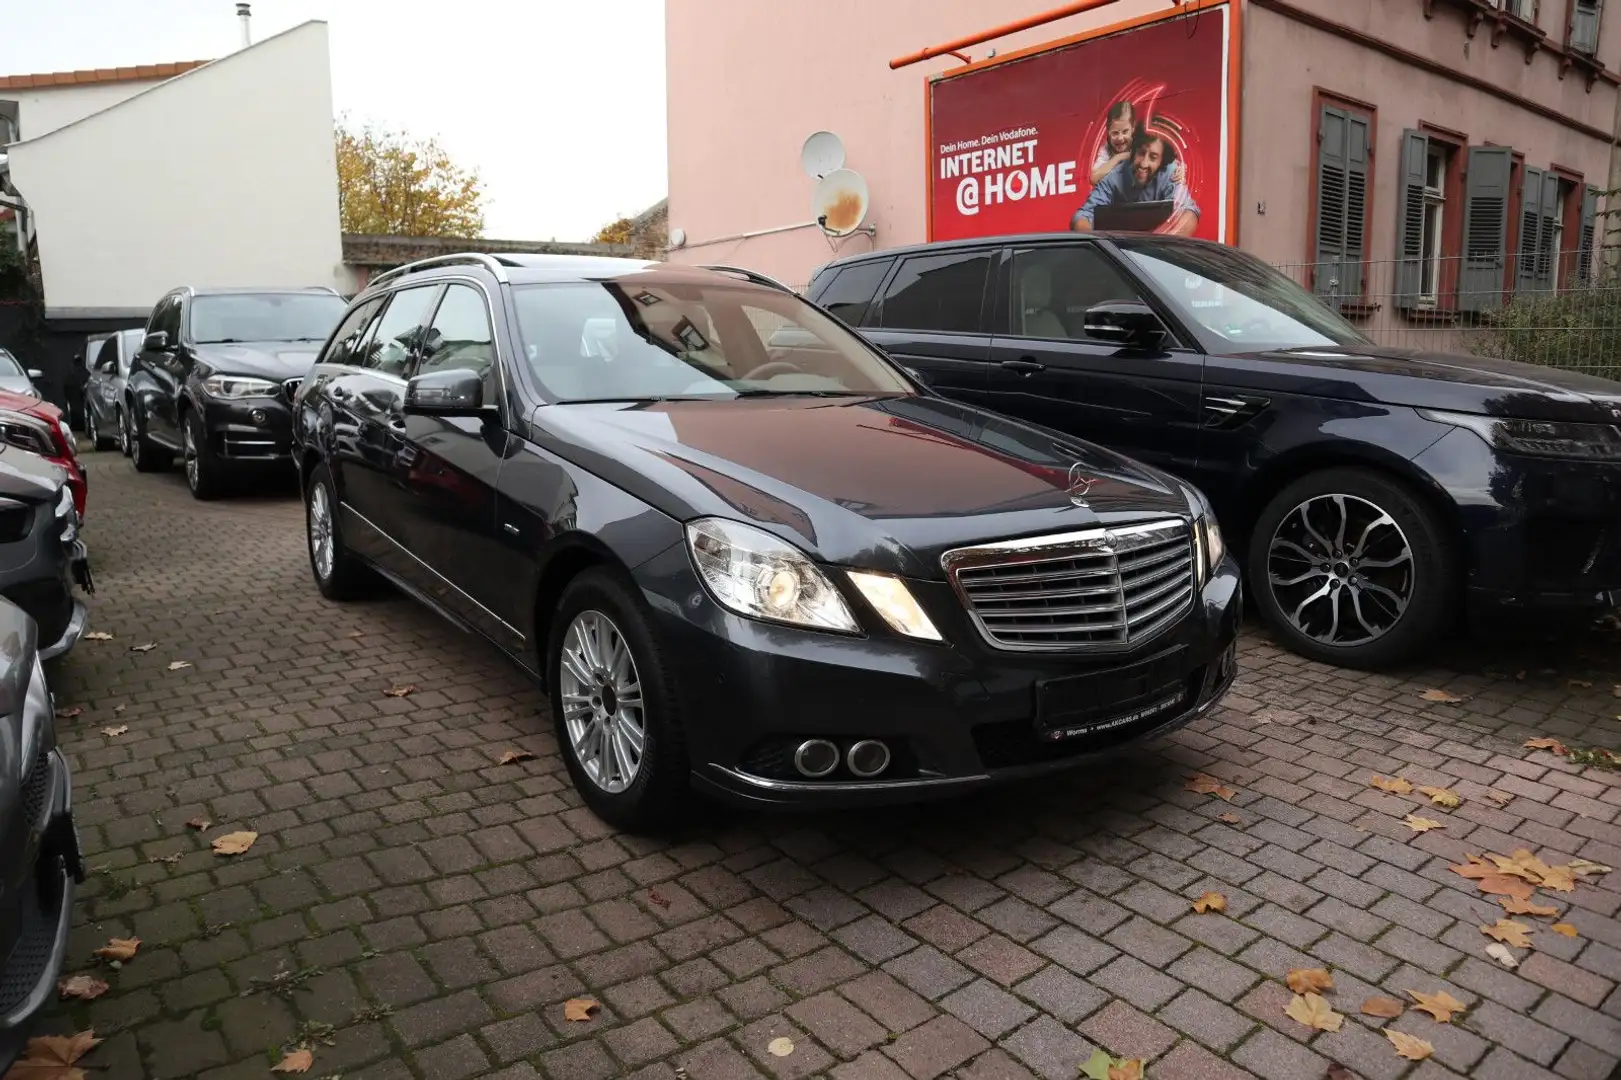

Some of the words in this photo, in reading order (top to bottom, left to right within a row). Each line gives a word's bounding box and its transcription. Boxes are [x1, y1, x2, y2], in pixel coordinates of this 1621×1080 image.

[940, 143, 957, 154] Dein
[958, 140, 981, 150] Home.
[982, 135, 999, 145] Dein
[1000, 127, 1038, 142] Vodafone.
[940, 139, 1038, 179] INTERNET
